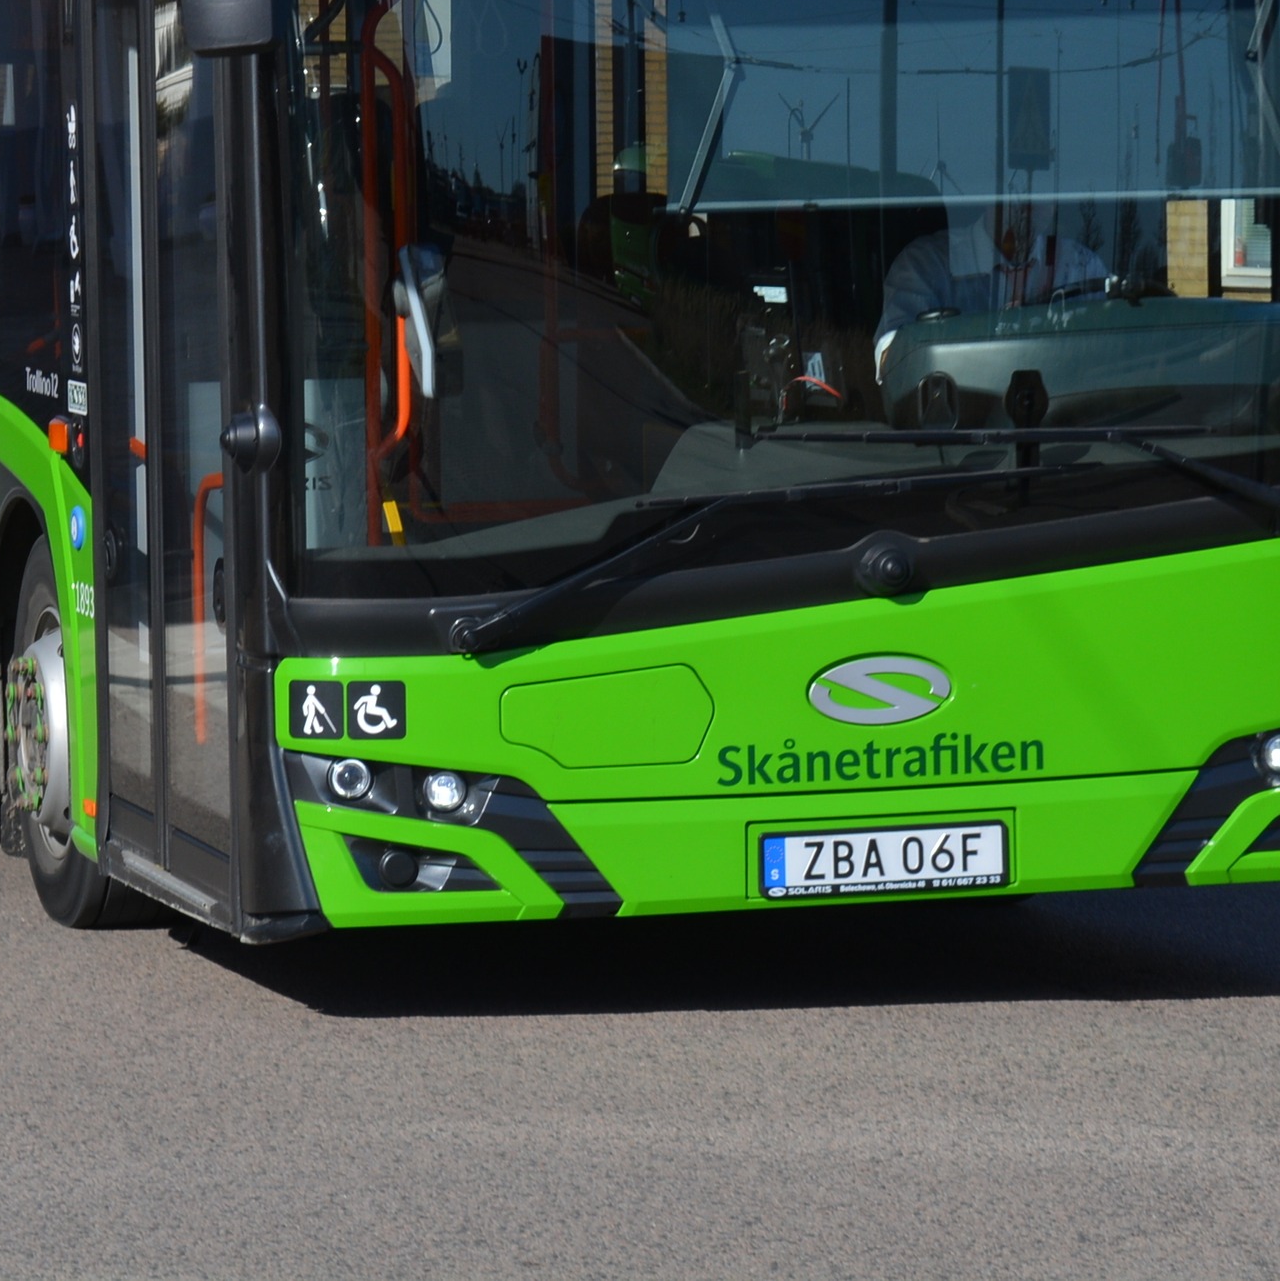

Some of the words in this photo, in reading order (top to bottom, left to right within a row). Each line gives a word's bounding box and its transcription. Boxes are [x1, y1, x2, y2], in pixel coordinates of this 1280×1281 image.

[25, 366, 51, 397] Trollino
[50, 372, 59, 399] 12
[76, 581, 95, 619] 1893
[717, 732, 1045, 787] Skånetrafiken
[803, 838, 885, 881] ZBA
[901, 832, 982, 875] 06F
[770, 869, 780, 881] S
[787, 885, 832, 895] SOLARIS
[975, 875, 988, 885] 23
[988, 874, 1001, 884] 33
